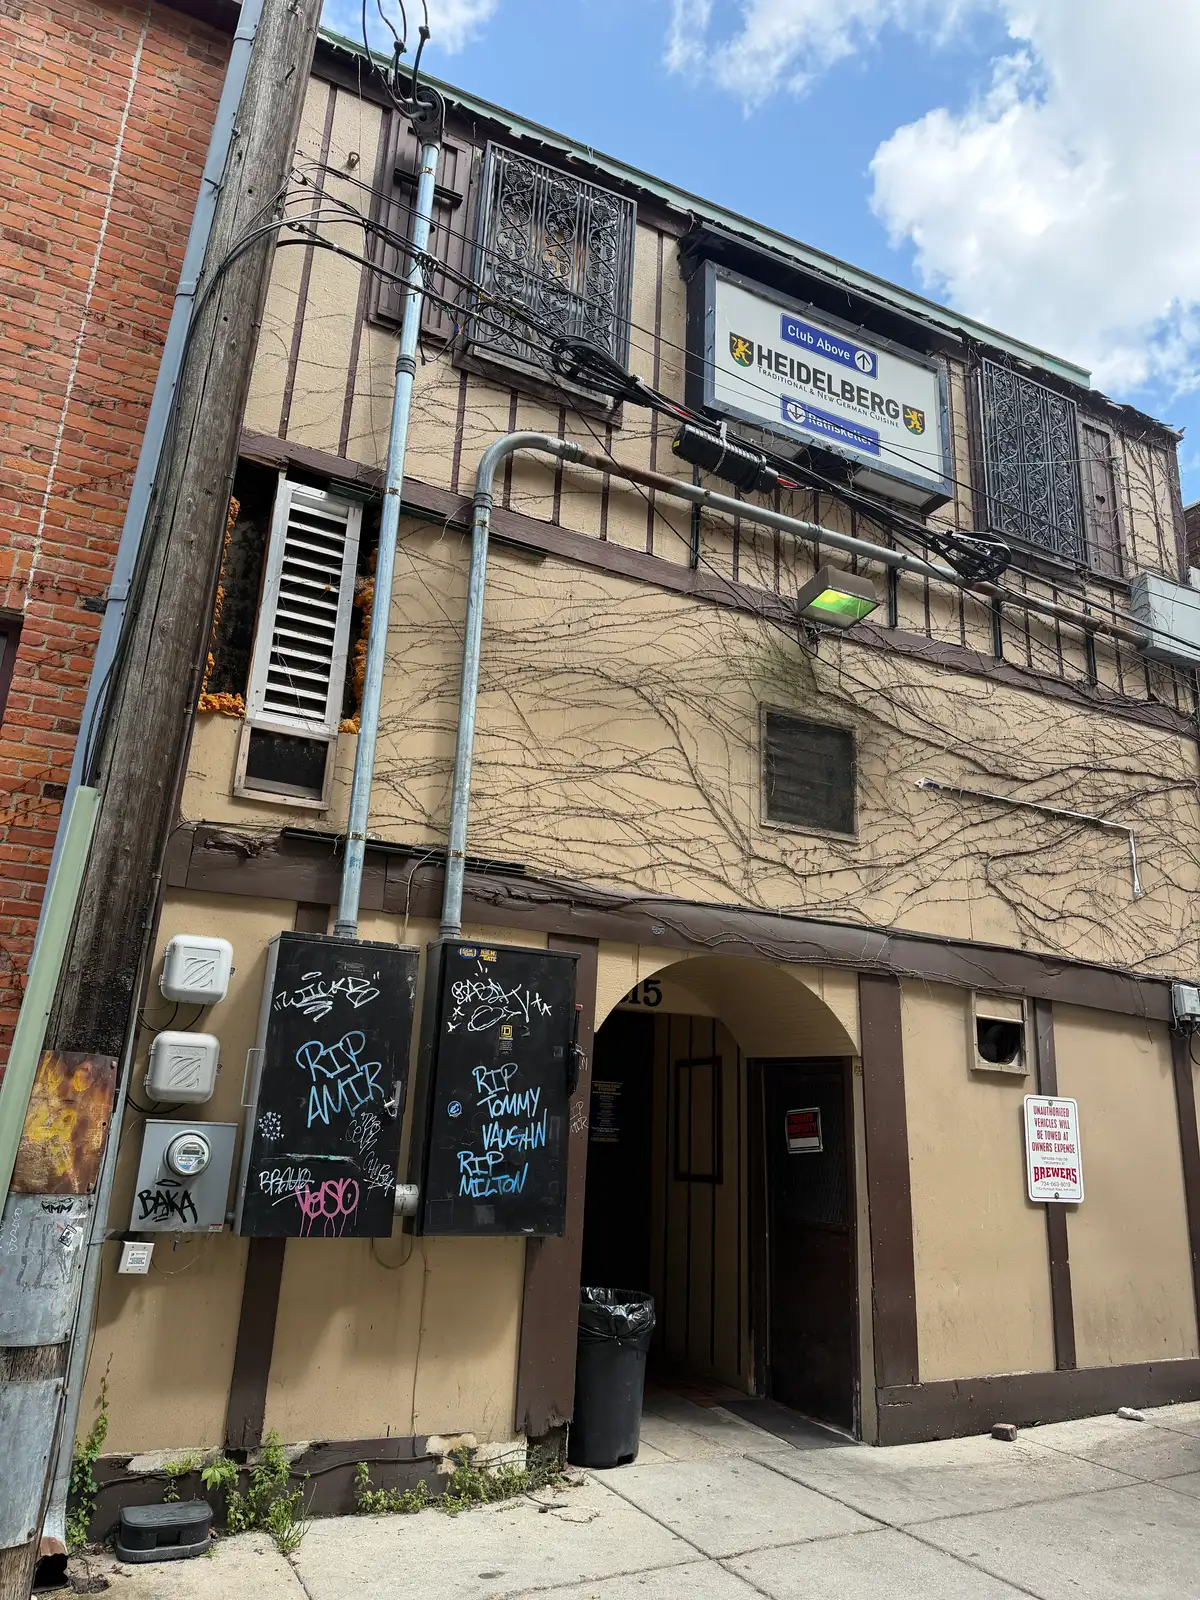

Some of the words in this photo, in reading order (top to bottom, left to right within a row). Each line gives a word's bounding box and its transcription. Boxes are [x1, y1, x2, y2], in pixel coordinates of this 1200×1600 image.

[787, 324, 814, 345] Club
[816, 337, 851, 361] Above
[756, 344, 900, 420] HEIDELBERG
[809, 388, 815, 397] &
[620, 977, 663, 1007] 15
[295, 1030, 366, 1083] RIP
[306, 1061, 385, 1129] AMIR
[471, 1062, 519, 1096] RIP
[476, 1086, 541, 1119] TOMMY
[1033, 1105, 1070, 1118] UNAUTHORIZED
[481, 1107, 548, 1153] VAUGHN
[1033, 1117, 1058, 1129] VEHICLES
[1059, 1119, 1071, 1130] WILL
[1036, 1129, 1044, 1140] BE
[1044, 1130, 1062, 1141] TOWED
[1063, 1131, 1069, 1141] AT
[456, 1151, 504, 1177] RIP
[1031, 1141, 1053, 1153] OWNERS
[1054, 1142, 1076, 1154] EXPENSE
[459, 1162, 529, 1198] MILTON
